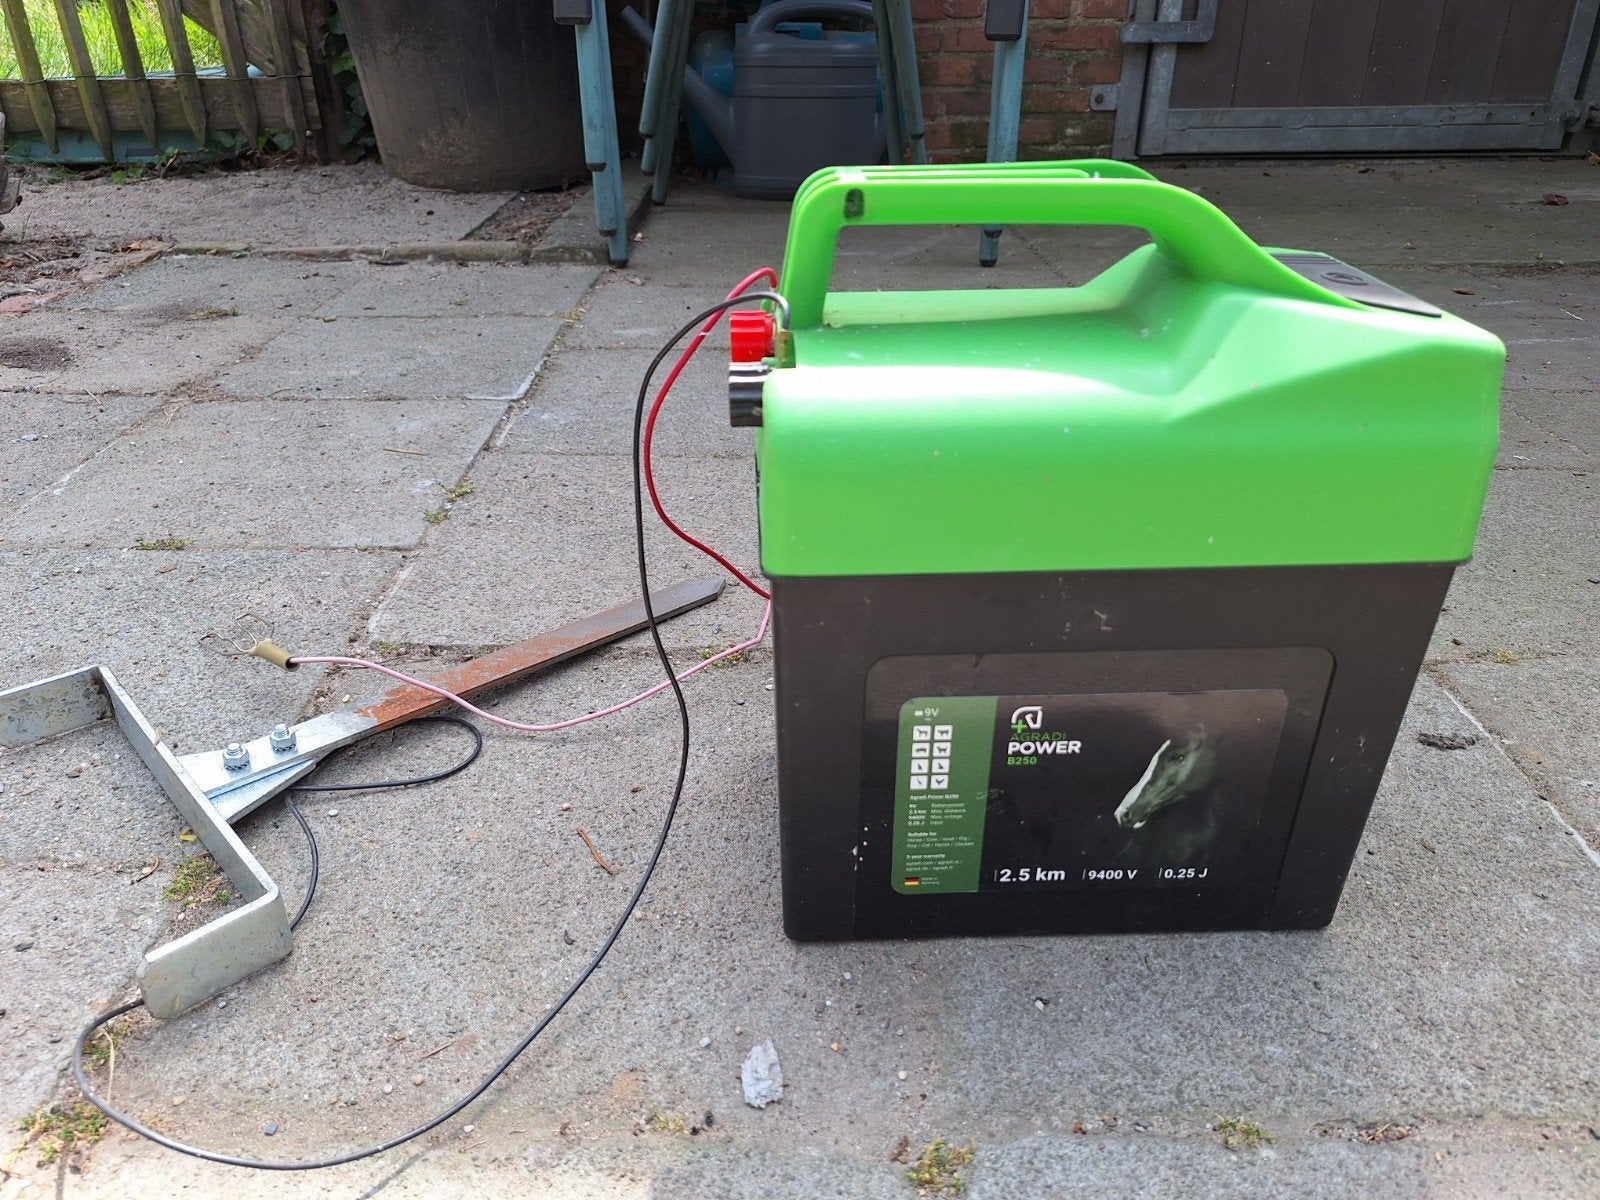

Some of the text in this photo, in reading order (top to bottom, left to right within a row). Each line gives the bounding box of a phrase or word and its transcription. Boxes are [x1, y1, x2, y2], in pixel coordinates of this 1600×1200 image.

[924, 707, 939, 717] 9V
[1009, 732, 1066, 741] AGRADI
[1007, 740, 1082, 755] POWER
[1007, 756, 1037, 765] B250
[999, 867, 1066, 882] 2.5 km
[1088, 869, 1138, 880] 9400 V
[1164, 868, 1208, 879] 0.25 J
